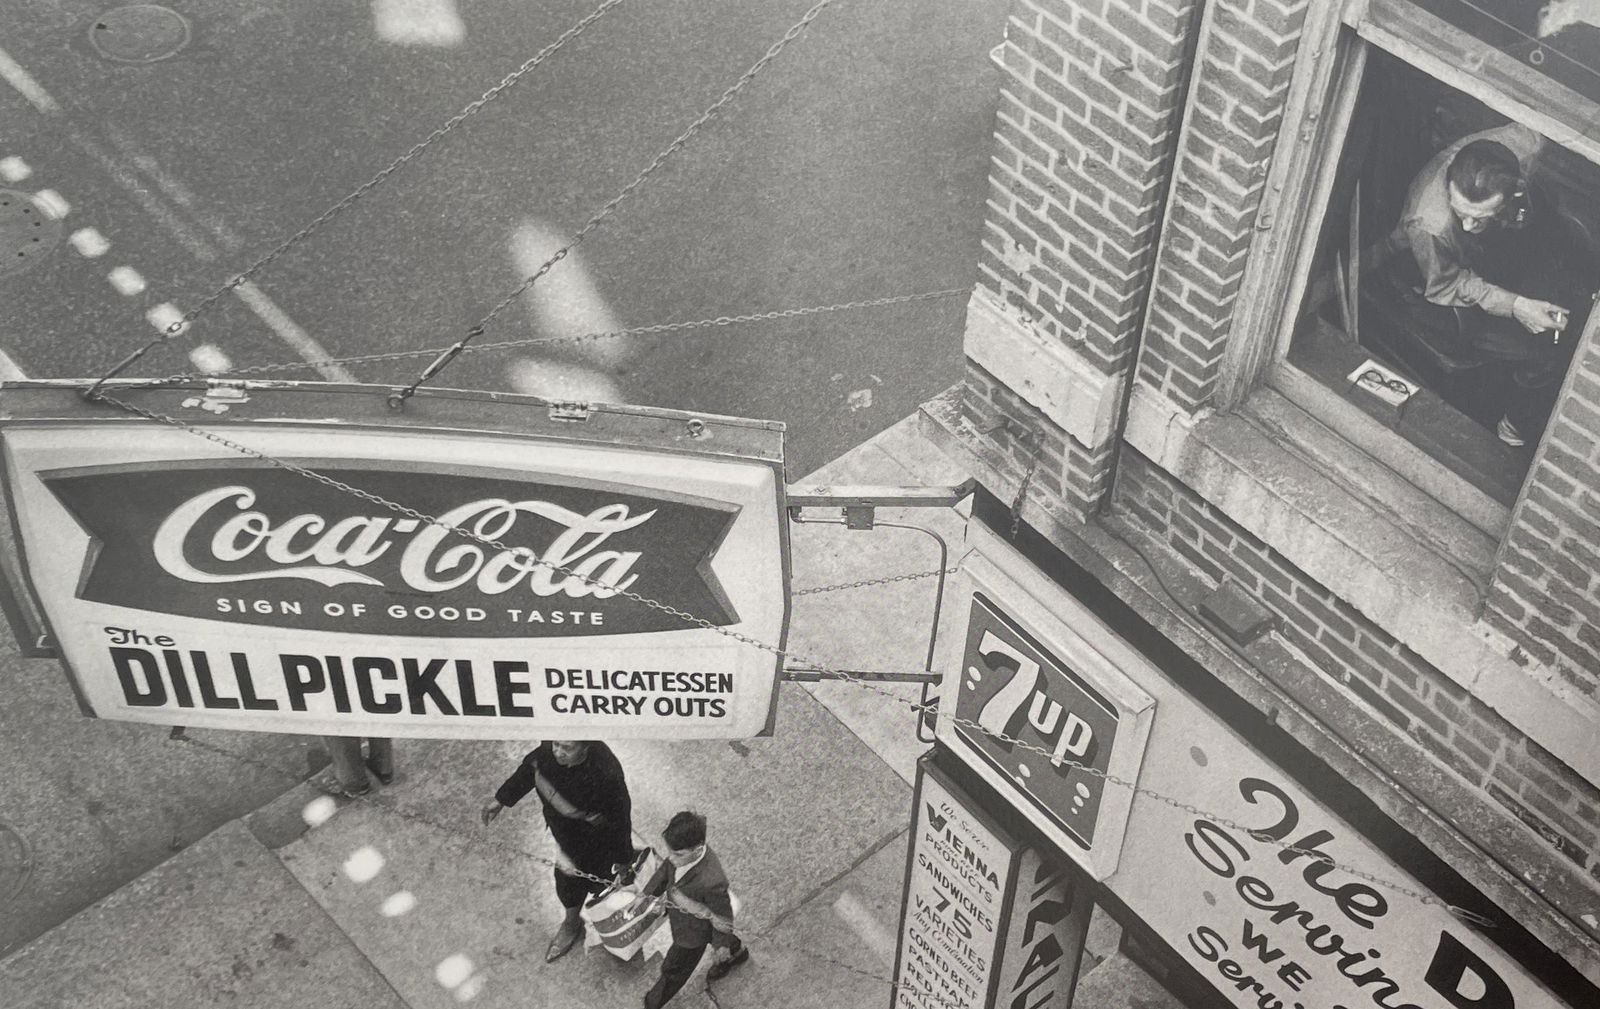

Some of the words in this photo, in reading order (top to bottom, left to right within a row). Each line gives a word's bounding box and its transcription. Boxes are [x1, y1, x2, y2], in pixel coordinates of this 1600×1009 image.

[153, 485, 656, 599] Coca-Cola
[104, 626, 176, 647] The
[216, 598, 302, 616] SIGN
[323, 603, 367, 617] OF
[387, 605, 487, 621] GOOD
[507, 609, 604, 625] TASTE
[109, 646, 279, 710] DILL
[279, 654, 534, 717] PICKLE
[545, 667, 733, 694] DELICATESSEN
[550, 693, 648, 715] CARRY
[653, 697, 726, 718] OUTS
[926, 801, 999, 892] VIENNA
[940, 802, 957, 820] We
[926, 832, 992, 903] PRODUCTS
[1239, 777, 1388, 930] The
[918, 853, 993, 932] SANDWICHES
[1185, 819, 1426, 1009] Servin
[909, 928, 949, 973] CORNED
[951, 969, 978, 1000] BEEF
[913, 910, 931, 933] Any
[931, 930, 984, 984] Combination
[915, 893, 985, 972] VARIETIES
[1188, 926, 1304, 1009] Serv
[1242, 918, 1312, 992] WE
[907, 962, 932, 992] RED
